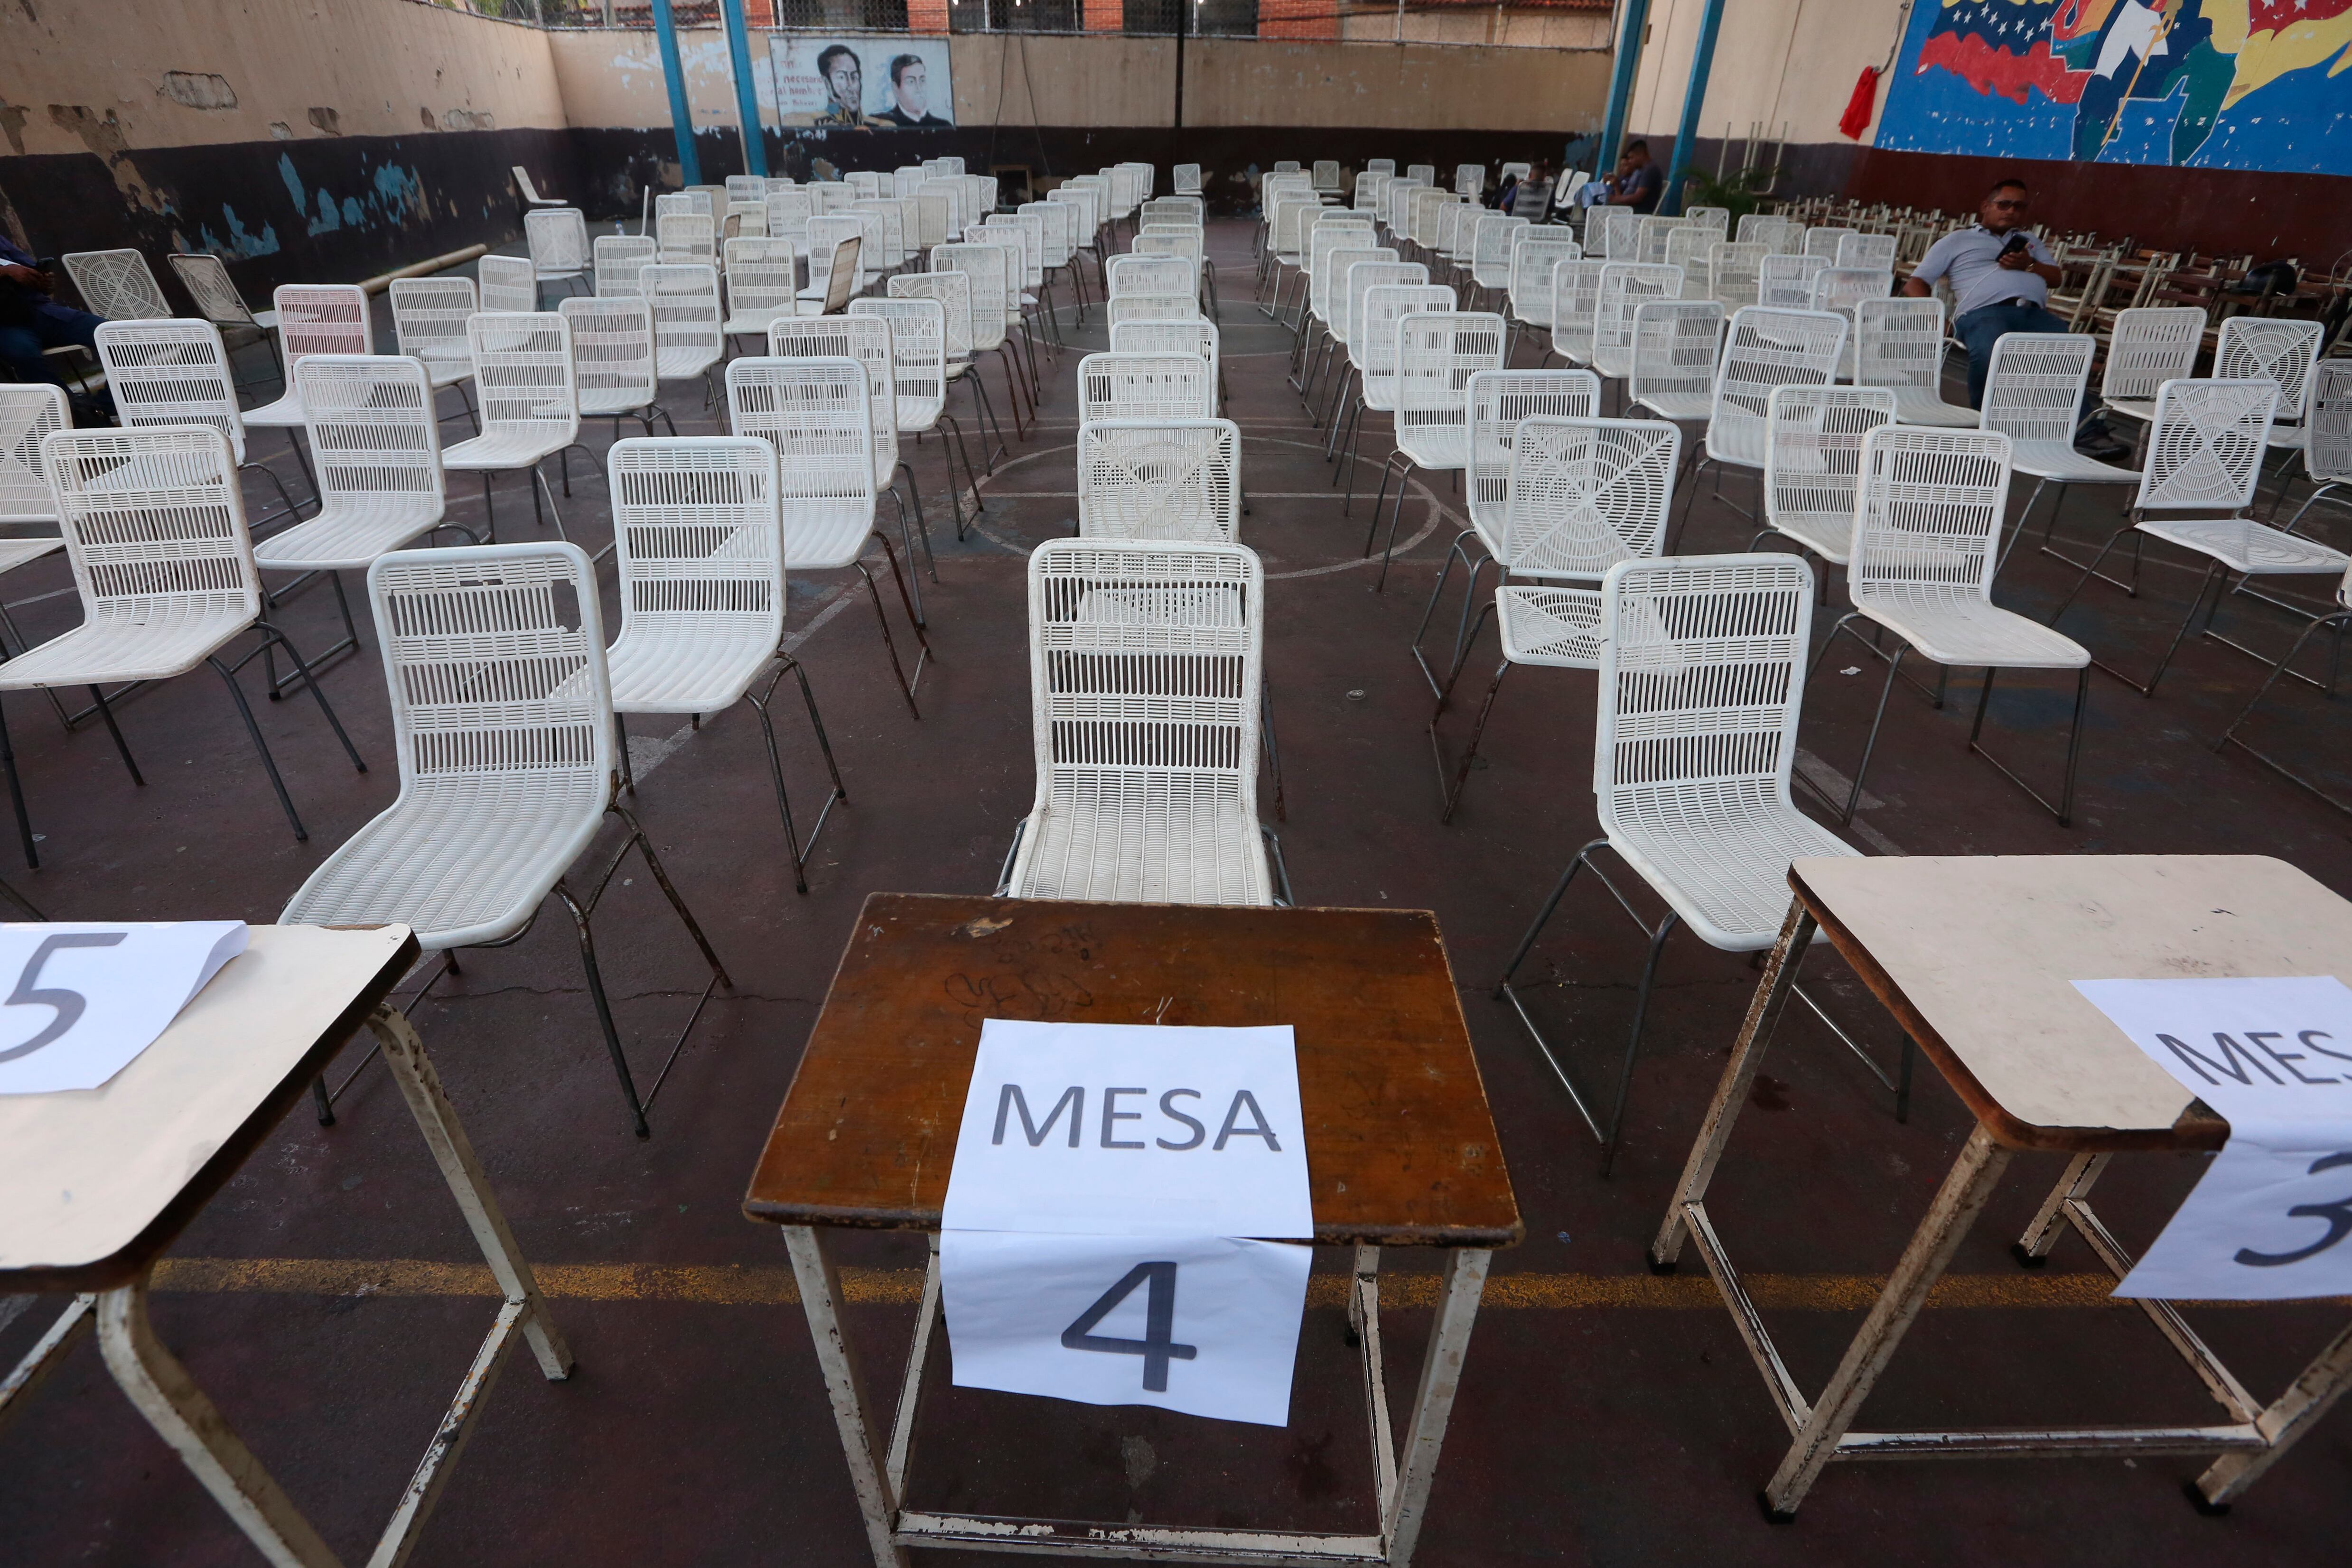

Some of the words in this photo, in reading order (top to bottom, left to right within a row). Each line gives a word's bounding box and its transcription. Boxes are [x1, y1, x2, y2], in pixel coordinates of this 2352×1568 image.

[789, 84, 822, 95] hombe
[0, 933, 128, 1063] 5
[991, 1084, 1282, 1152] MESA
[2233, 1152, 2352, 1267] 3
[1061, 1261, 1198, 1392] 4
